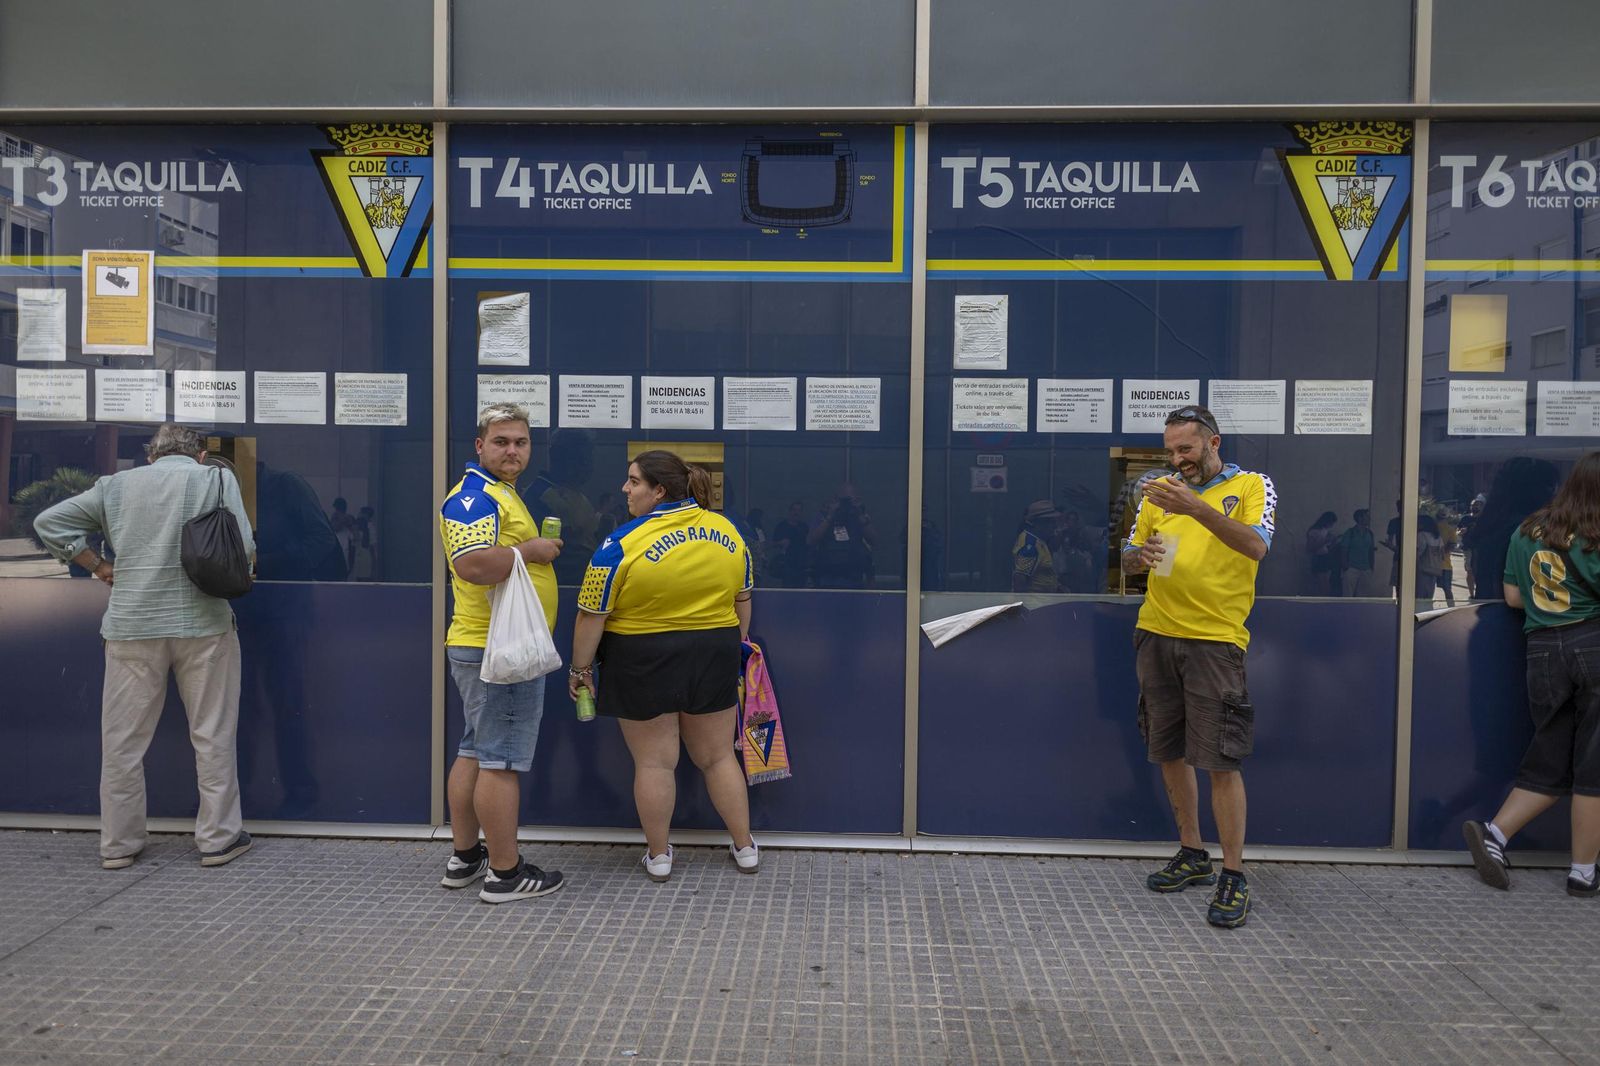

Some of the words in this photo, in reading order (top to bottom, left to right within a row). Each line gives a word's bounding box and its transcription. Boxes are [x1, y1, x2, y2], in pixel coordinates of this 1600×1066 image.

[74, 161, 243, 192] TAQUILLA
[348, 160, 386, 173] CADIZ
[391, 160, 412, 173] C.F.
[1018, 161, 1200, 193] TAQUILLA
[1315, 159, 1356, 173] CADIZ
[1360, 159, 1384, 173] C.F.
[2, 157, 68, 207] T3
[458, 157, 535, 208] T4
[538, 163, 713, 194] TAQUILLA
[941, 157, 1015, 209] T5
[1440, 155, 1515, 208] T6
[80, 196, 119, 207] TICKET
[122, 196, 164, 207] OFFICE
[543, 198, 584, 210] TICKET
[588, 198, 632, 210] OFFICE
[1023, 197, 1068, 210] TICKET
[1070, 197, 1116, 210] OFFICE
[1526, 196, 1570, 209] TICKET
[181, 381, 237, 391] INCIDENCIAS
[649, 387, 706, 397] INCIDENCIAS
[1131, 390, 1190, 400] INCIDENCIAS
[644, 530, 686, 564] CHRIS
[688, 527, 737, 554] RAMOS
[1529, 550, 1571, 613] 8
